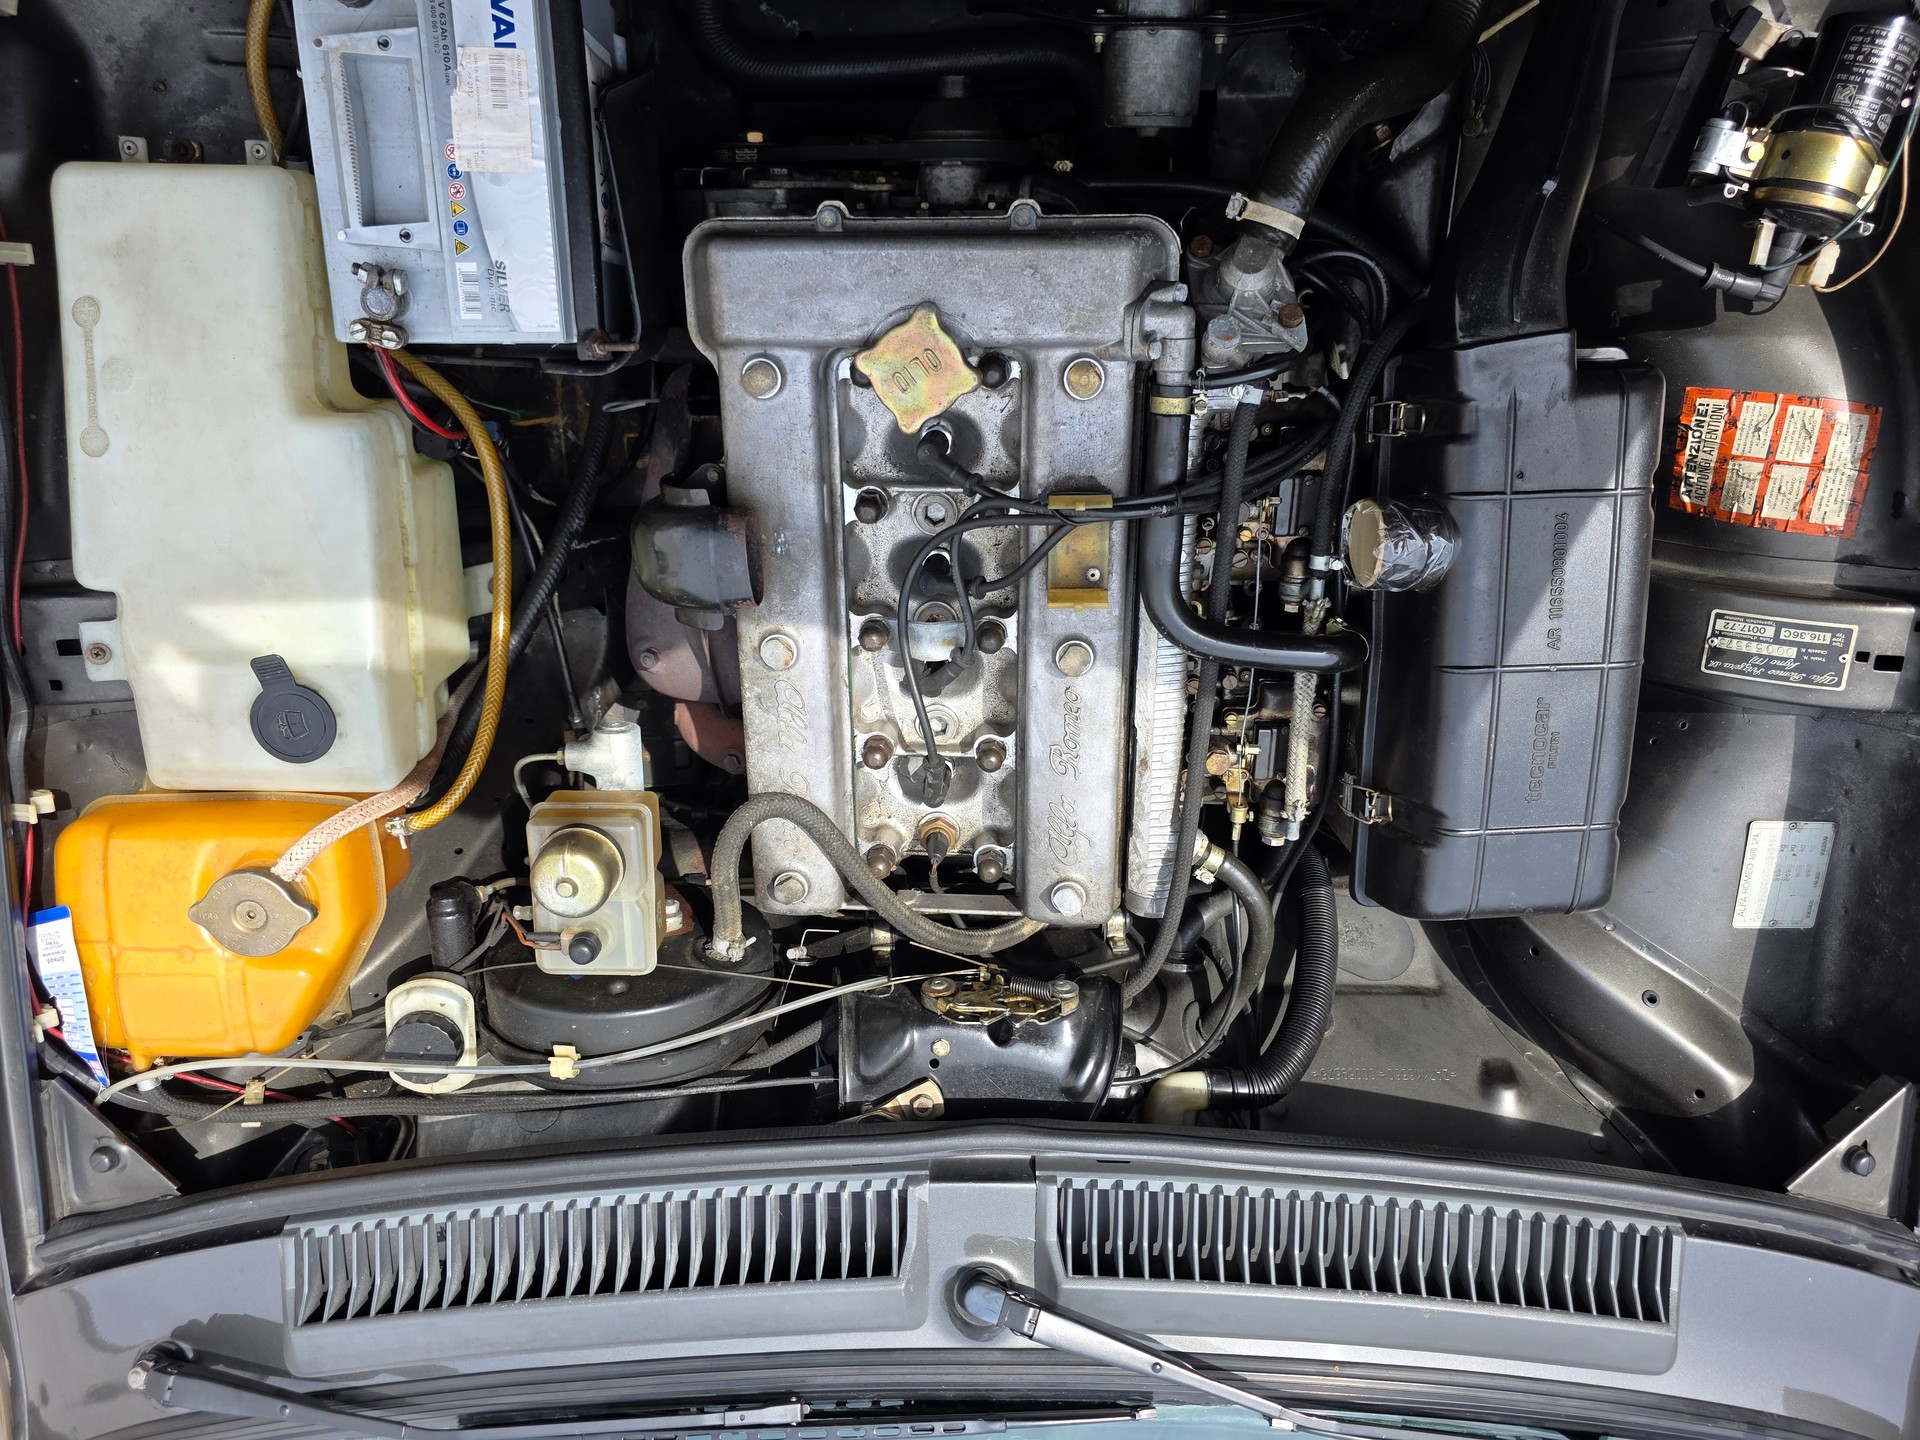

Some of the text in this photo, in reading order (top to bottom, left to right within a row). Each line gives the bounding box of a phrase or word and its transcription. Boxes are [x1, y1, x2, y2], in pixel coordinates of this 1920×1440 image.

[439, 13, 447, 41] 63Ah
[443, 44, 451, 72] 610A
[487, 268, 496, 312] Dynamic
[495, 260, 510, 313] SILVER
[892, 348, 942, 394] OLIO
[1682, 402, 1711, 499] ATTENZIONE!
[1694, 403, 1726, 502] ACHTUNG! ATTENTION!
[1547, 628, 1562, 651] AR
[1723, 622, 1766, 634] 0017.72
[1782, 630, 1828, 642] 116.36C
[1768, 669, 1806, 682] Romeo
[1809, 672, 1838, 685] Alfa
[758, 679, 808, 755] Alfa
[1524, 696, 1552, 803] tecnocar
[1547, 731, 1560, 769] FILTRI
[1047, 686, 1094, 866] Alfa Romeo
[1742, 863, 1754, 894] ROMEO
[1738, 896, 1748, 917] ALFA
